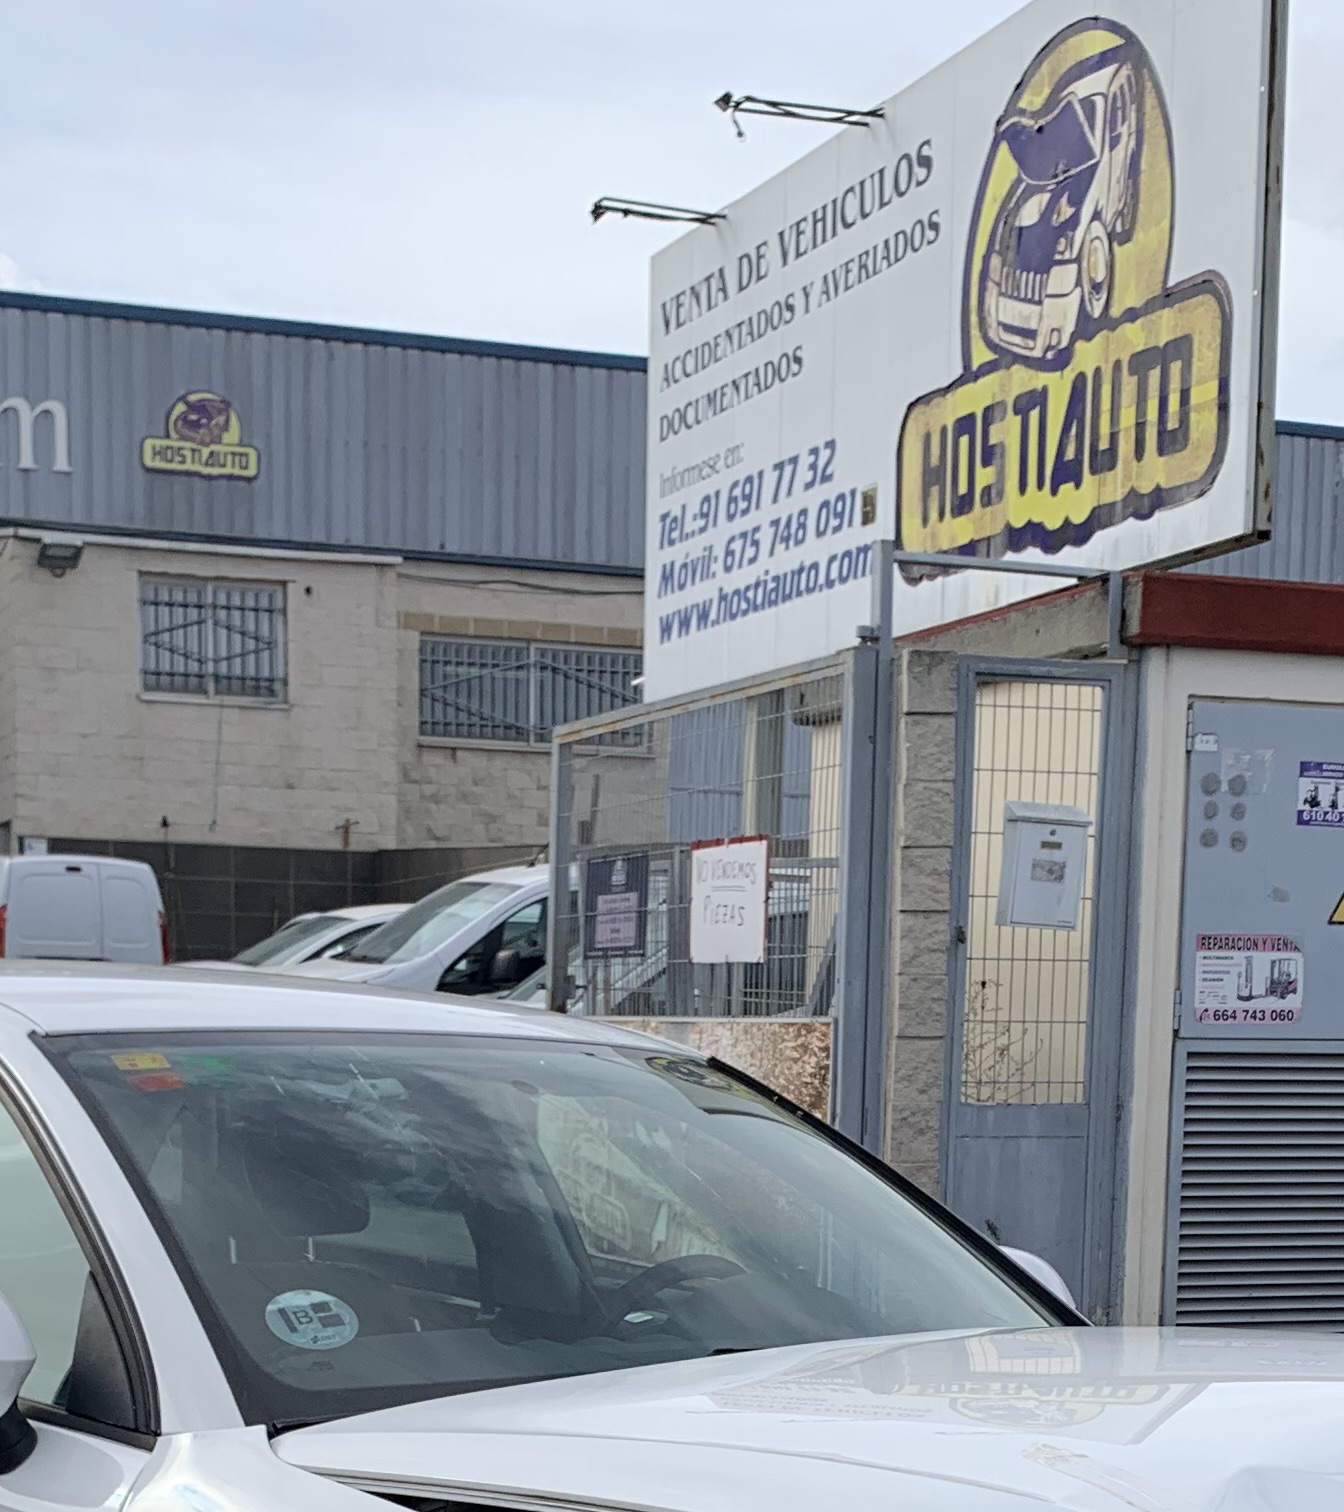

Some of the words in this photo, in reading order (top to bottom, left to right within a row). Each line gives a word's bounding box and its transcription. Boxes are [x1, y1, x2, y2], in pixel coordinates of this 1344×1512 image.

[660, 266, 730, 337] VENTA
[736, 240, 770, 295] DE
[777, 138, 933, 268] VEHICULOS
[659, 292, 796, 393] ACCIDENTADOS
[800, 281, 815, 316] Y
[816, 208, 942, 309] AVERIADOS
[658, 344, 805, 444] DOCUMENTADOS
[921, 332, 1194, 530] HOSTIAUTO
[151, 444, 250, 471] HOSTIAUTO
[726, 469, 765, 523] 691
[770, 453, 801, 505] 77
[803, 438, 837, 492] 32
[657, 544, 719, 600] Móvil:
[722, 524, 762, 575] 675
[768, 507, 809, 558] 748
[815, 487, 858, 540] 091
[1302, 810, 1324, 821] 610
[1325, 811, 1340, 822] 40
[1200, 936, 1259, 951] REPARACION
[1262, 937, 1268, 951] Y
[1213, 1009, 1237, 1021] 664
[1242, 1009, 1266, 1021] 743
[1270, 1009, 1295, 1021] 060
[291, 1310, 314, 1325] B
